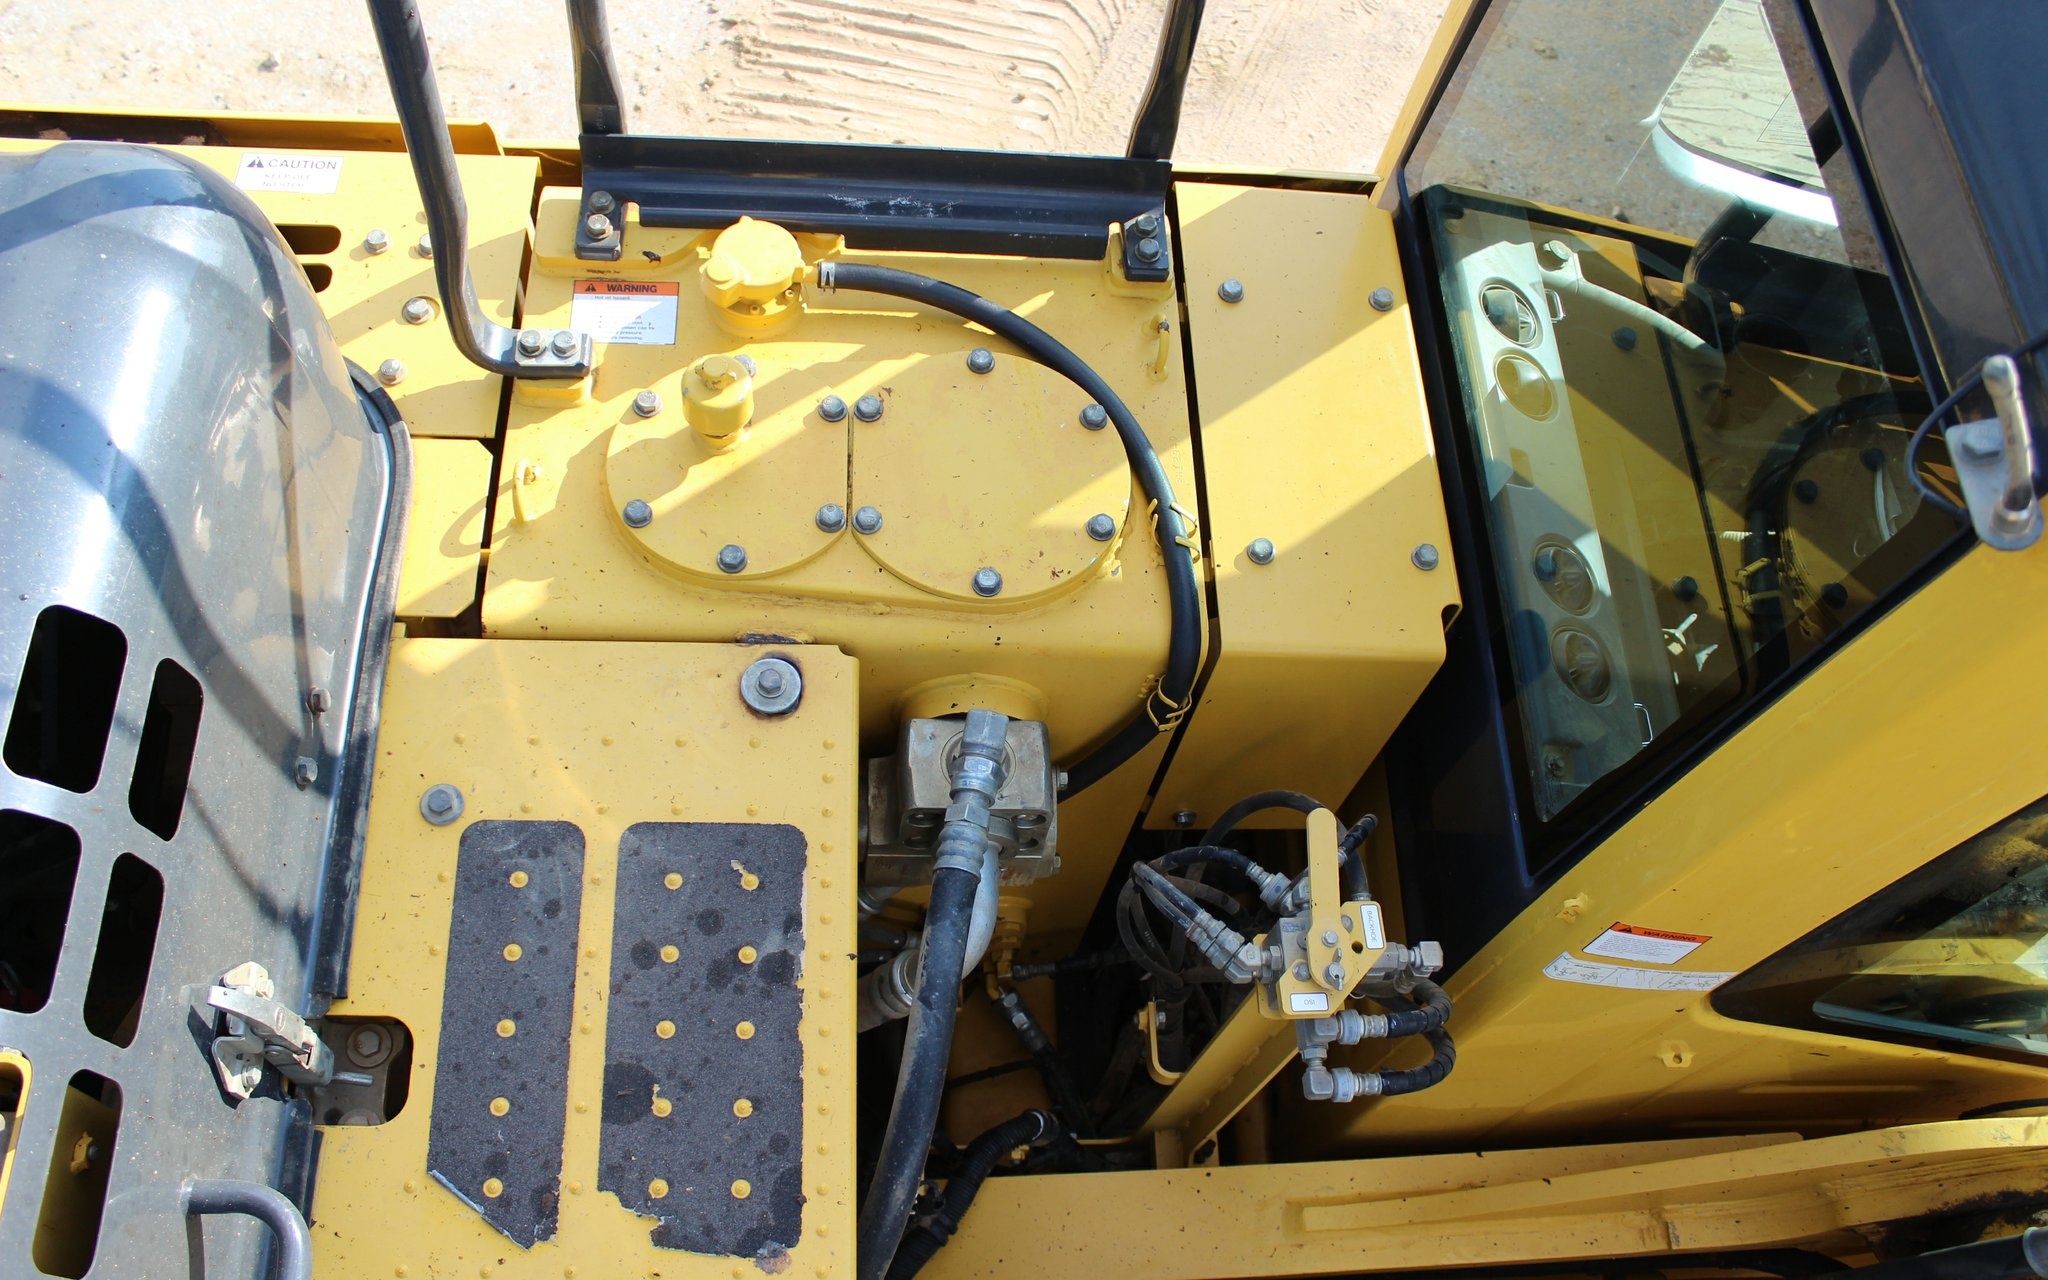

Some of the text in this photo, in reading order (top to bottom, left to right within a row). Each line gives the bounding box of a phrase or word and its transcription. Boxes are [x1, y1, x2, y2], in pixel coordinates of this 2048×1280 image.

[268, 158, 337, 170] CAUTION
[606, 283, 658, 293] WARNING
[1366, 910, 1378, 943] BACKHOE
[1642, 930, 1697, 942] WARNING
